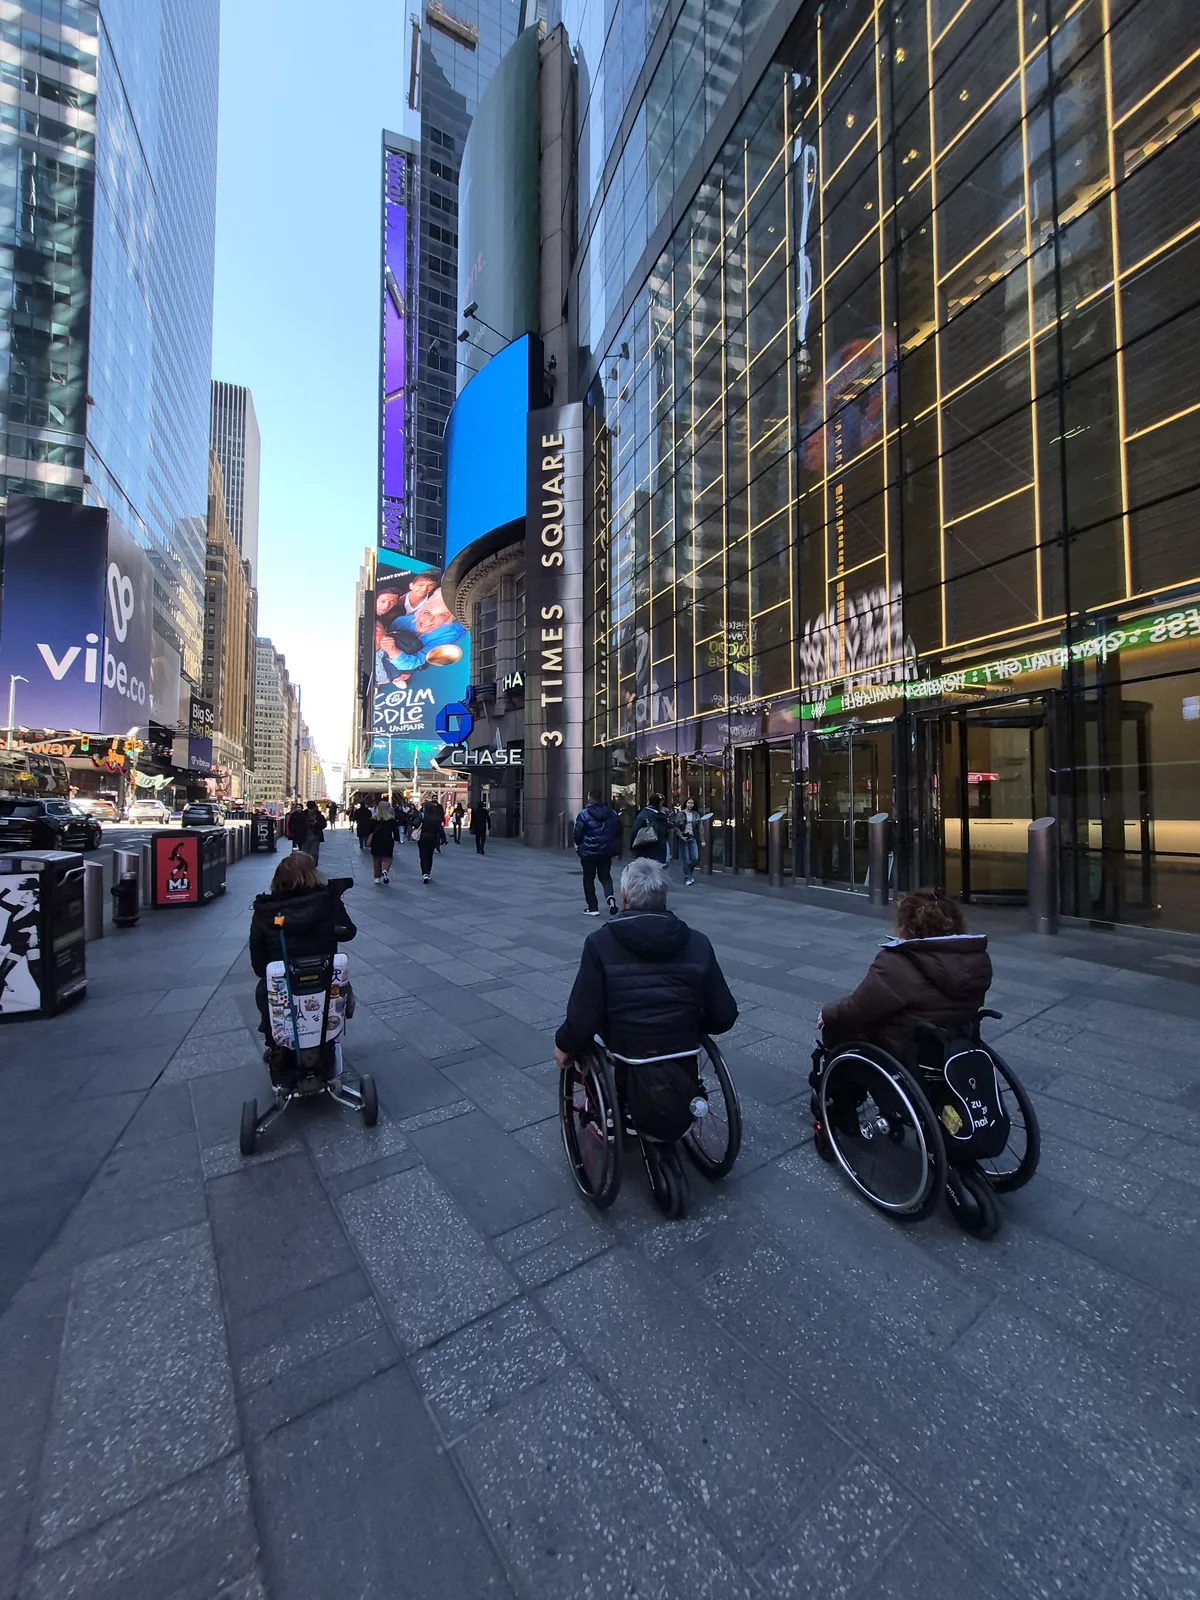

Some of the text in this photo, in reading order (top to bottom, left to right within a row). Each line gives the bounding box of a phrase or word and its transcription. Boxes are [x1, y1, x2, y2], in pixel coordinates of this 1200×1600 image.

[383, 501, 404, 549] ROK
[541, 432, 563, 747] 3 TIMES SQUARE
[37, 633, 146, 706] vibe.co
[502, 671, 526, 692] HA
[192, 703, 205, 724] Big
[389, 723, 425, 732] UNFAIR
[451, 749, 522, 765] CHASE
[169, 878, 188, 890] MJ
[971, 1100, 982, 1109] zu
